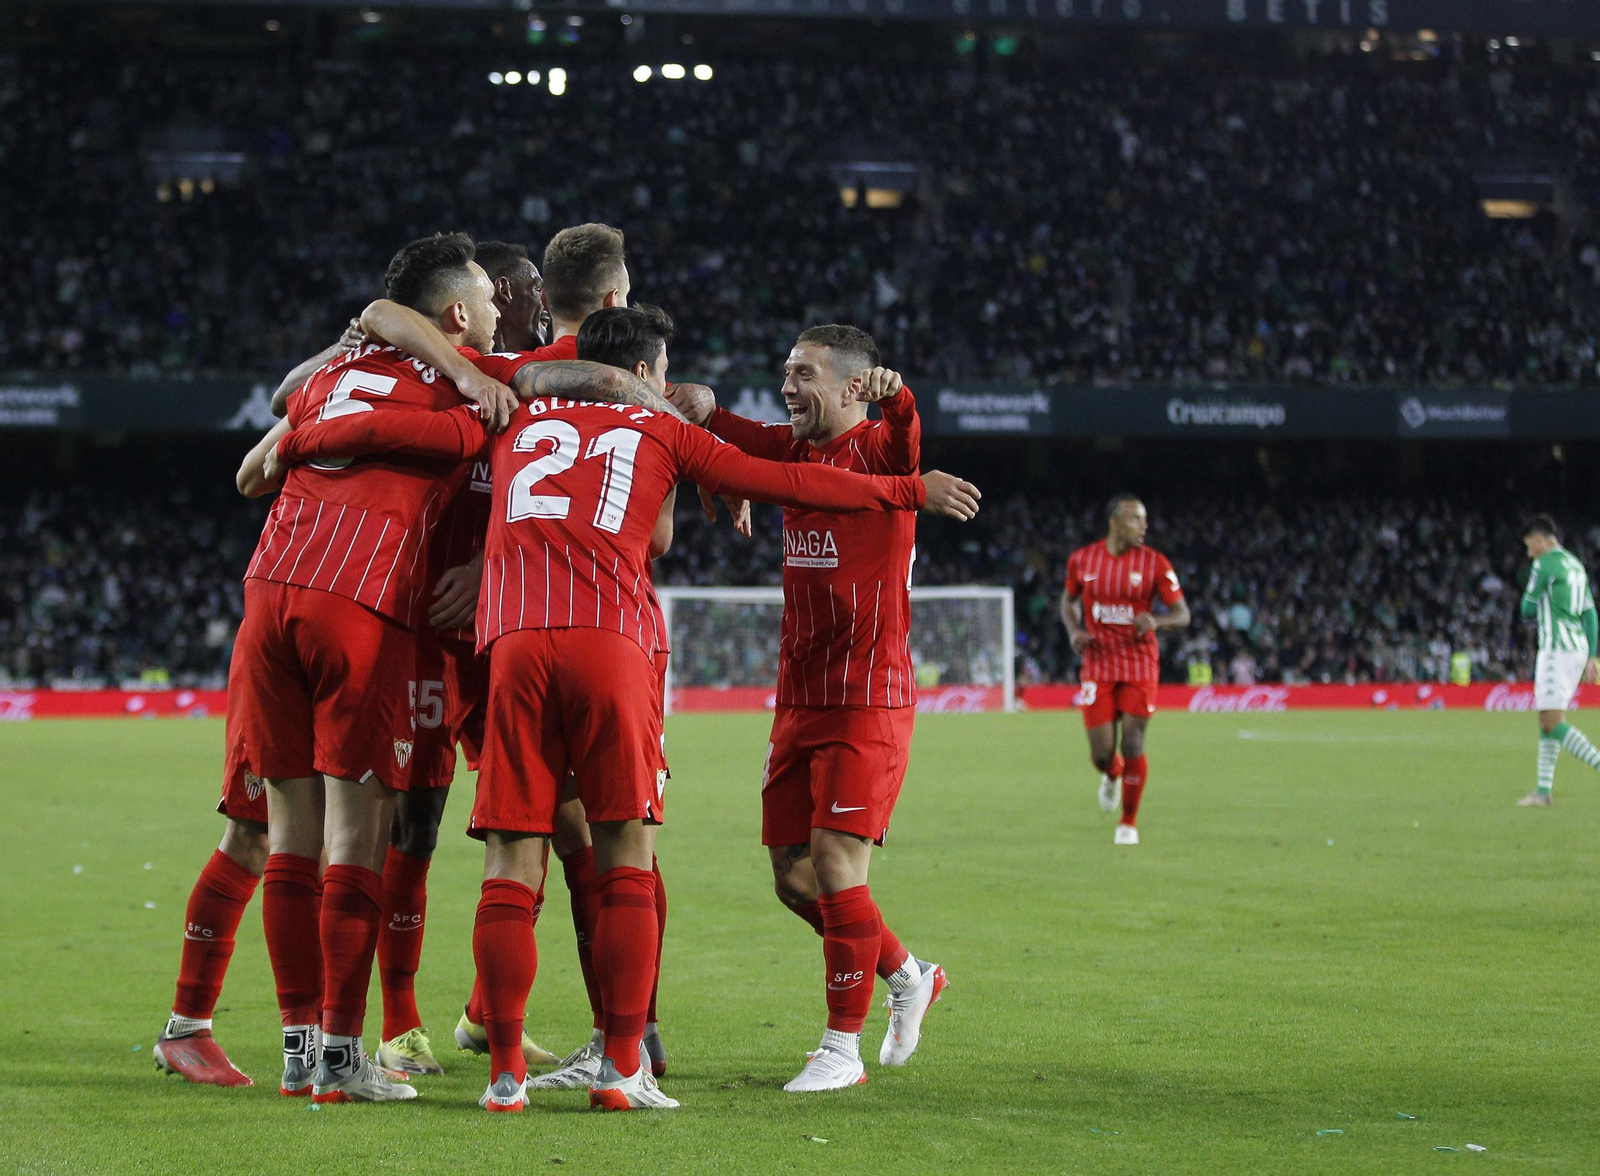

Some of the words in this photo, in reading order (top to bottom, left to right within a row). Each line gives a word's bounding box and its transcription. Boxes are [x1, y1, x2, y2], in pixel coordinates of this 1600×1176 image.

[506, 419, 642, 534] 21
[786, 530, 838, 556] NAGA
[392, 913, 421, 923] SFC
[834, 970, 863, 983] SFC
